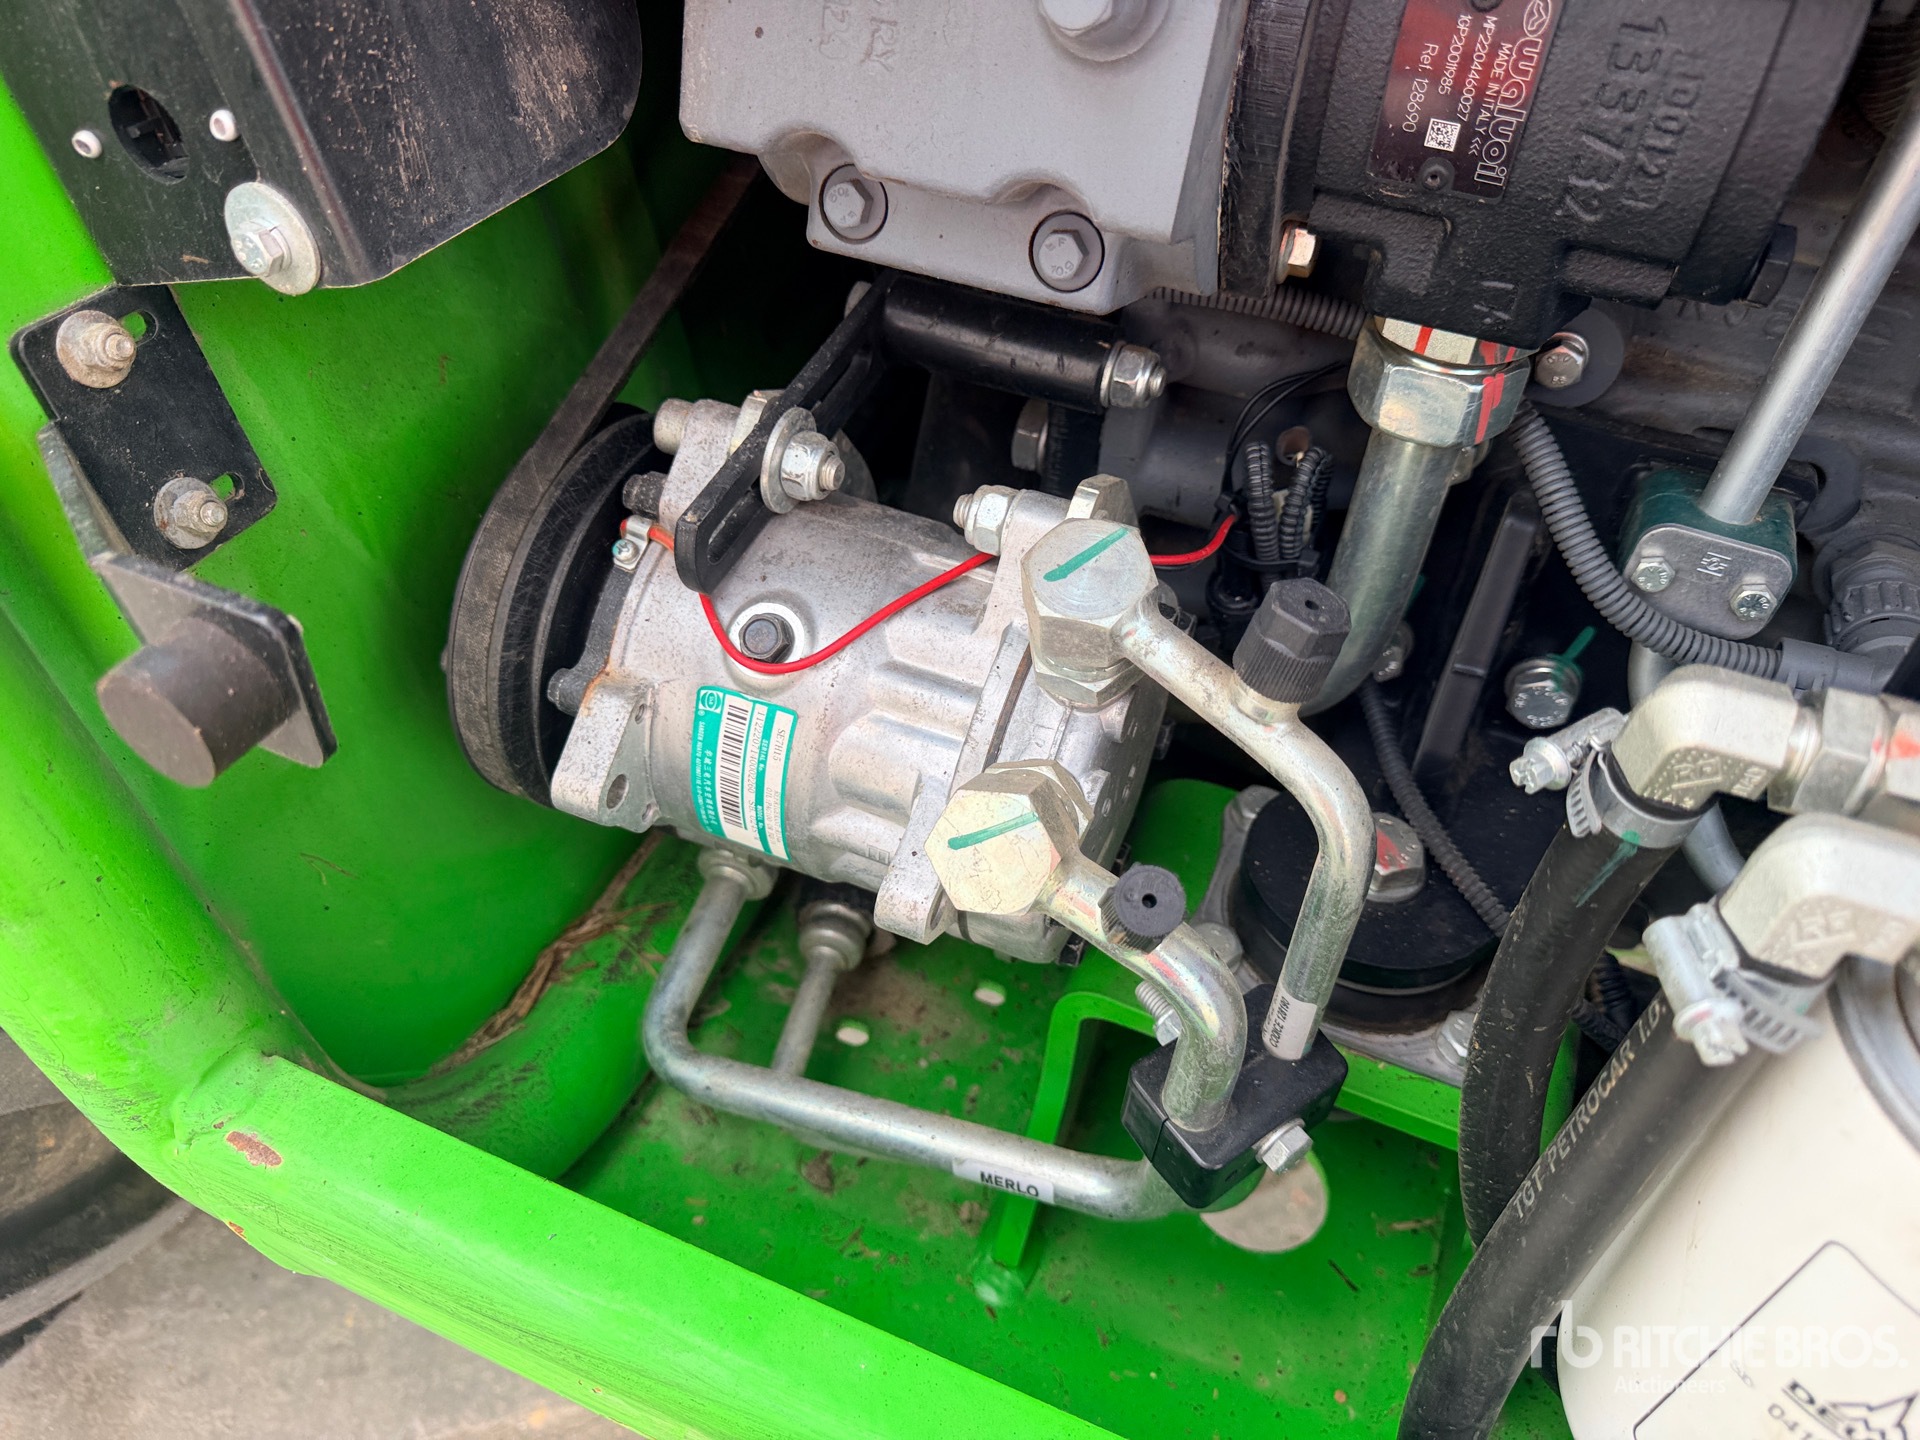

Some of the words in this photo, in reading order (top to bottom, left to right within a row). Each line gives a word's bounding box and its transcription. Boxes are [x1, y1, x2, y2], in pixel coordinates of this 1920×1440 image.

[1418, 42, 1440, 73] Ref.
[1457, 15, 1499, 122] MP2204460027
[1490, 42, 1513, 80] MADE
[1402, 77, 1429, 133] 128690
[1485, 82, 1501, 97] IN
[1475, 98, 1495, 136] ITALY
[759, 738, 769, 761] SERIAL
[773, 728, 786, 762] SE7H15
[1269, 1018, 1284, 1048] CODICE
[1513, 1167, 1543, 1219] TGT
[1547, 1040, 1636, 1174] PETROCAR
[980, 1171, 1039, 1197] MERLO
